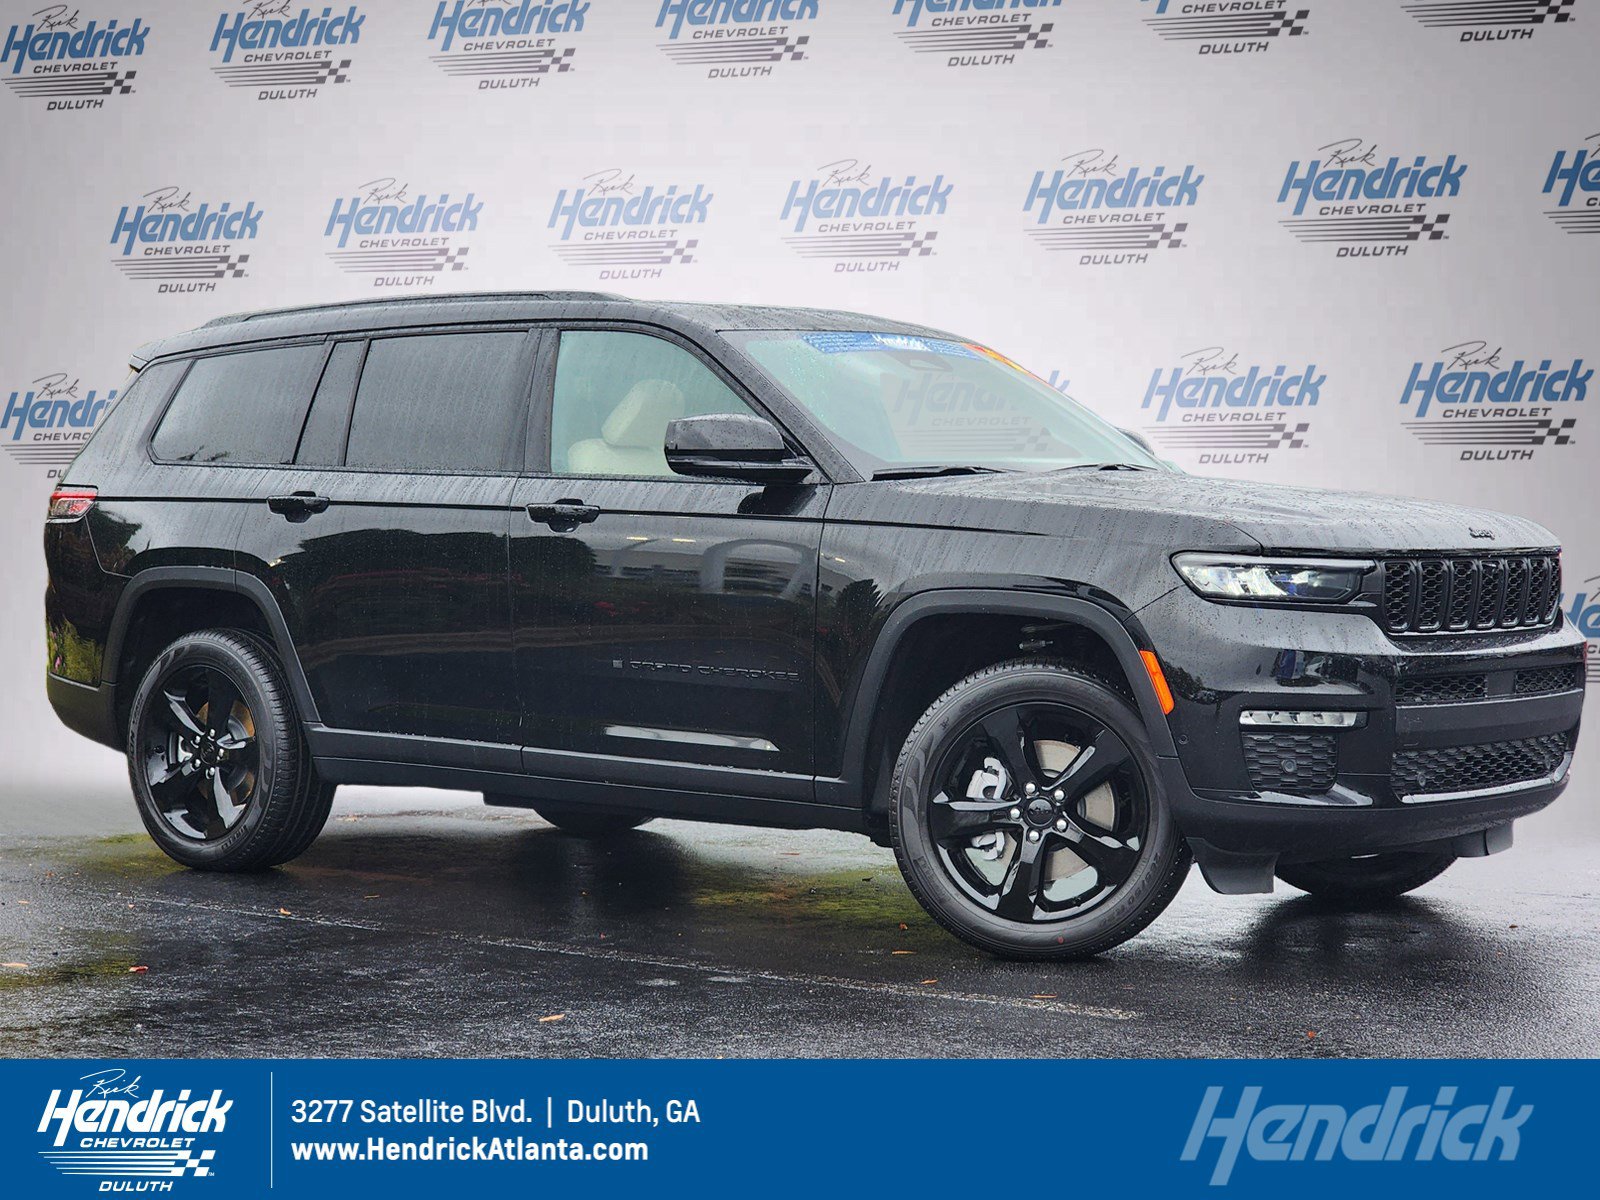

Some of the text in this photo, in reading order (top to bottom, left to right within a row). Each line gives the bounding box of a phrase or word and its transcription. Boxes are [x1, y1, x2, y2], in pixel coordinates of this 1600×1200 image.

[1181, 0, 1287, 14] CHEVROLET
[427, 0, 591, 51] Hendrick
[931, 13, 1032, 27] CHEVROLET
[209, 6, 367, 63] Hendrick
[692, 26, 789, 40] CHEVROLET
[1459, 28, 1534, 42] DULUTH
[0, 20, 149, 74] Hendrick
[463, 38, 556, 51] CHEVROLET
[1198, 41, 1269, 55] DULUTH
[243, 50, 332, 63] CHEVROLET
[947, 54, 1015, 67] DULUTH
[32, 61, 118, 74] CHEVROLET
[707, 66, 773, 79] DULUTH
[478, 77, 541, 90] DULUTH
[258, 88, 318, 101] DULUTH
[46, 98, 104, 111] DULUTH
[1277, 155, 1468, 215] Hendrick
[1023, 165, 1205, 224] Hendrick
[780, 175, 954, 232] Hendrick
[1319, 203, 1427, 216] CHEVROLET
[547, 184, 713, 241] Hendrick
[1063, 212, 1165, 225] CHEVROLET
[324, 193, 485, 248] Hendrick
[818, 221, 917, 233] CHEVROLET
[110, 202, 264, 256] Hendrick
[583, 229, 679, 241] CHEVROLET
[144, 244, 231, 256] CHEVROLET
[359, 237, 450, 250] CHEVROLET
[1336, 245, 1409, 258] DULUTH
[1079, 253, 1148, 266] DULUTH
[833, 260, 901, 273] DULUTH
[598, 268, 663, 280] DULUTH
[373, 275, 435, 287] DULUTH
[157, 282, 217, 294] DULUTH
[1141, 364, 1327, 422] Hendrick
[1399, 359, 1594, 418] Hendrick
[0, 389, 117, 441] Hendri
[1182, 411, 1287, 423] CHEVROLET
[1442, 407, 1553, 419] CHEVROLET
[1199, 452, 1269, 464] DULUTH
[1460, 449, 1535, 461] DULUTH
